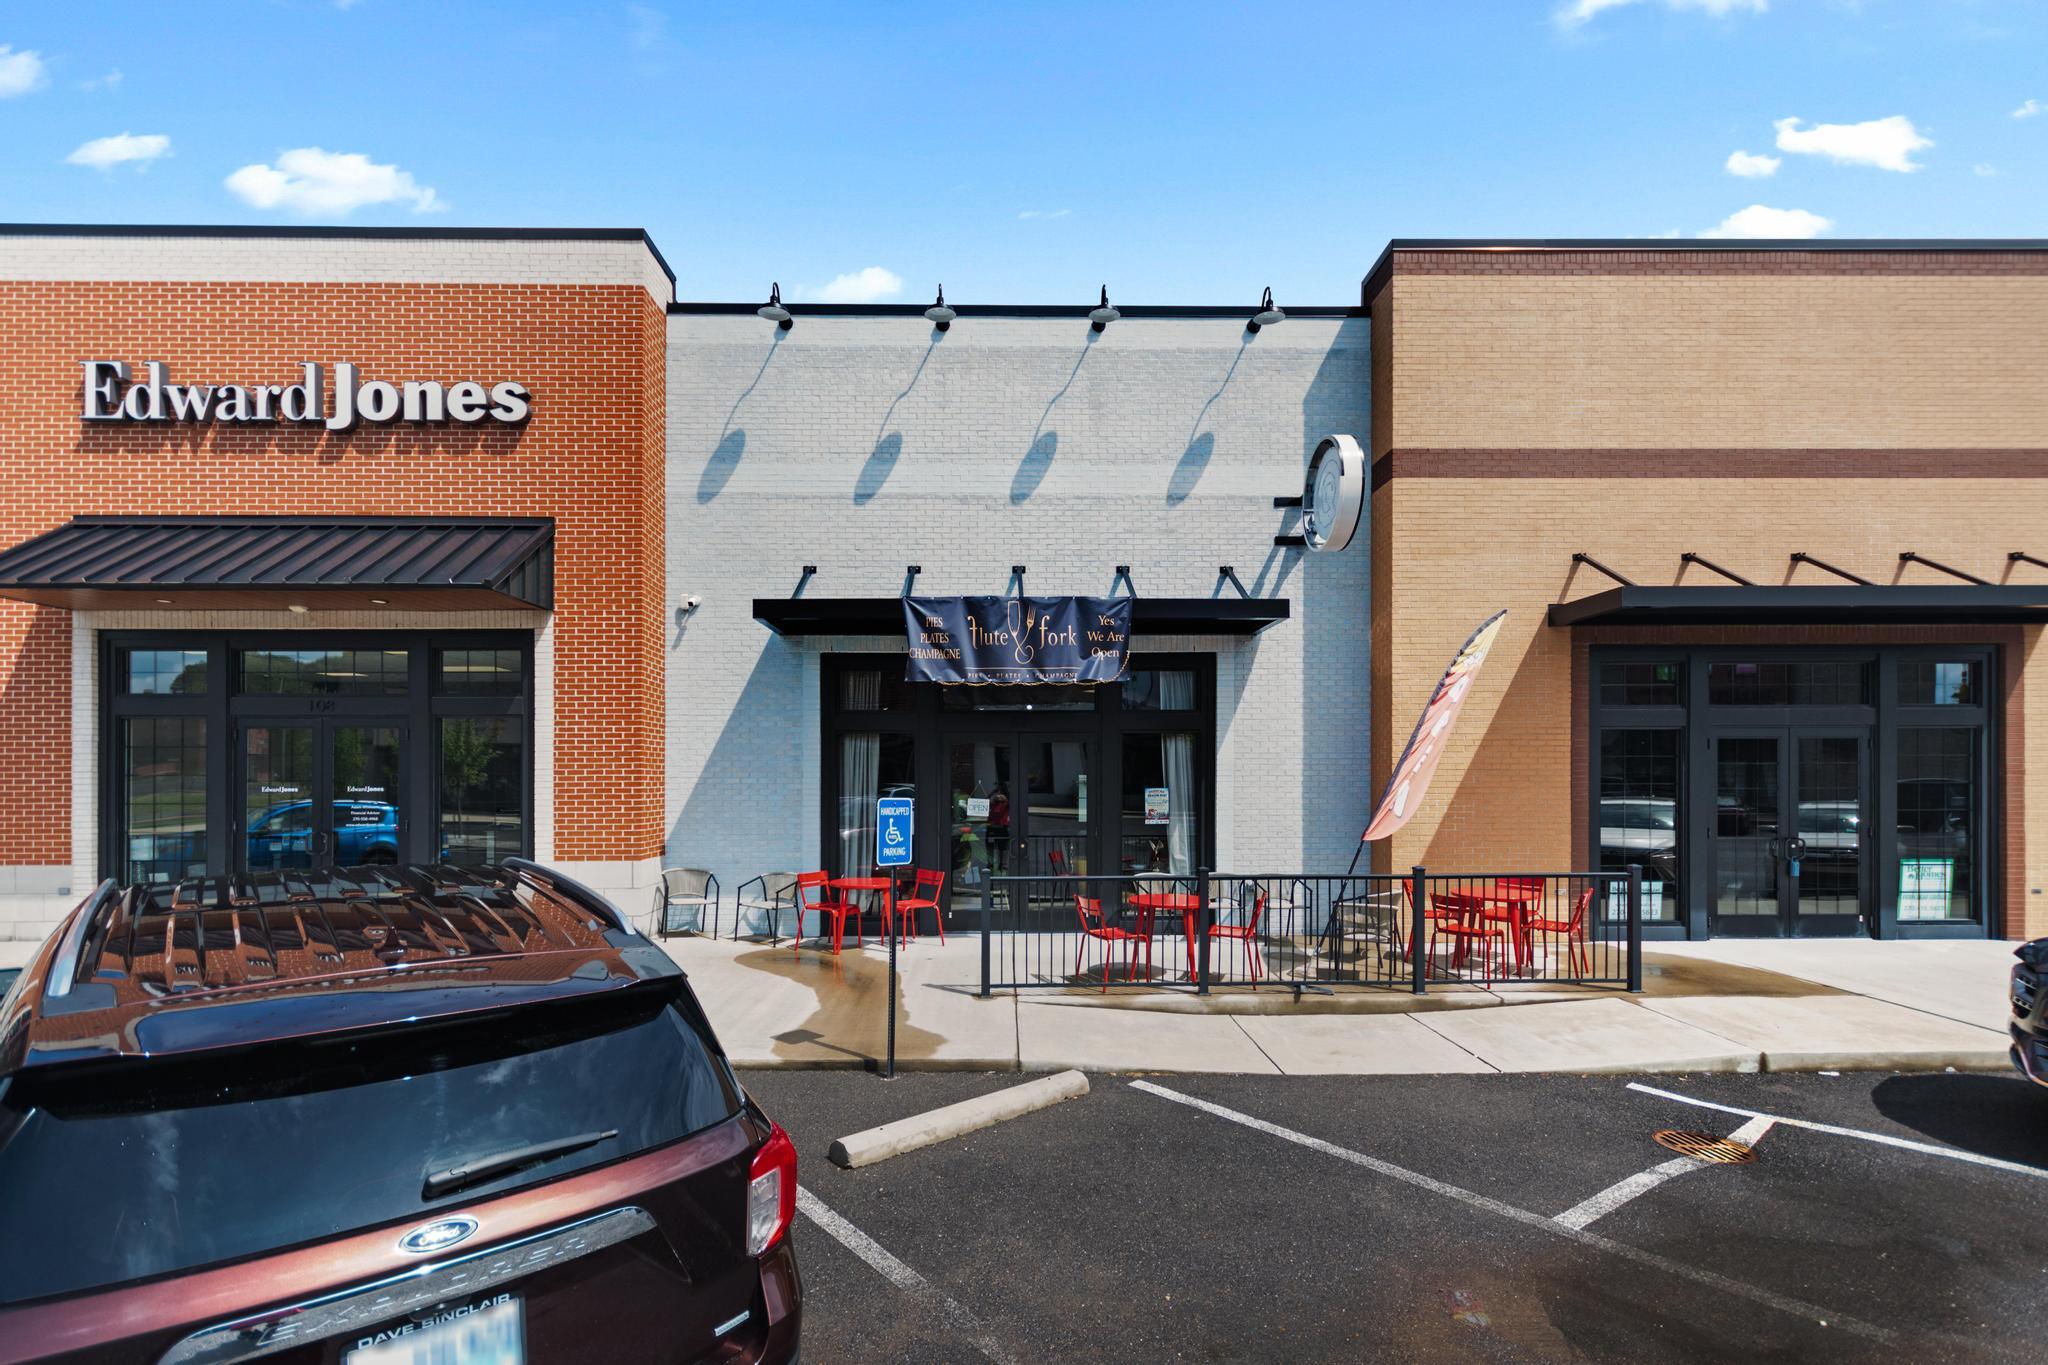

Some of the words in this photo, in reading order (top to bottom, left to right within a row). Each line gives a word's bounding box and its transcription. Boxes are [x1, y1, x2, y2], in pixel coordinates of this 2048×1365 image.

[926, 616, 943, 628] PIES
[1098, 615, 1115, 626] Yes
[967, 615, 1009, 650] flute
[1039, 615, 1077, 650] fork
[1087, 631, 1105, 641] We
[1107, 631, 1125, 642] Are
[920, 633, 949, 644] PLATES
[909, 648, 961, 659] CHAMPAGNE
[1091, 647, 1120, 661] Open
[880, 807, 910, 816] HANDICAPPED
[883, 847, 906, 857] PARKING
[358, 1322, 415, 1350] DAVE
[422, 1292, 512, 1330] SINCLAIR
